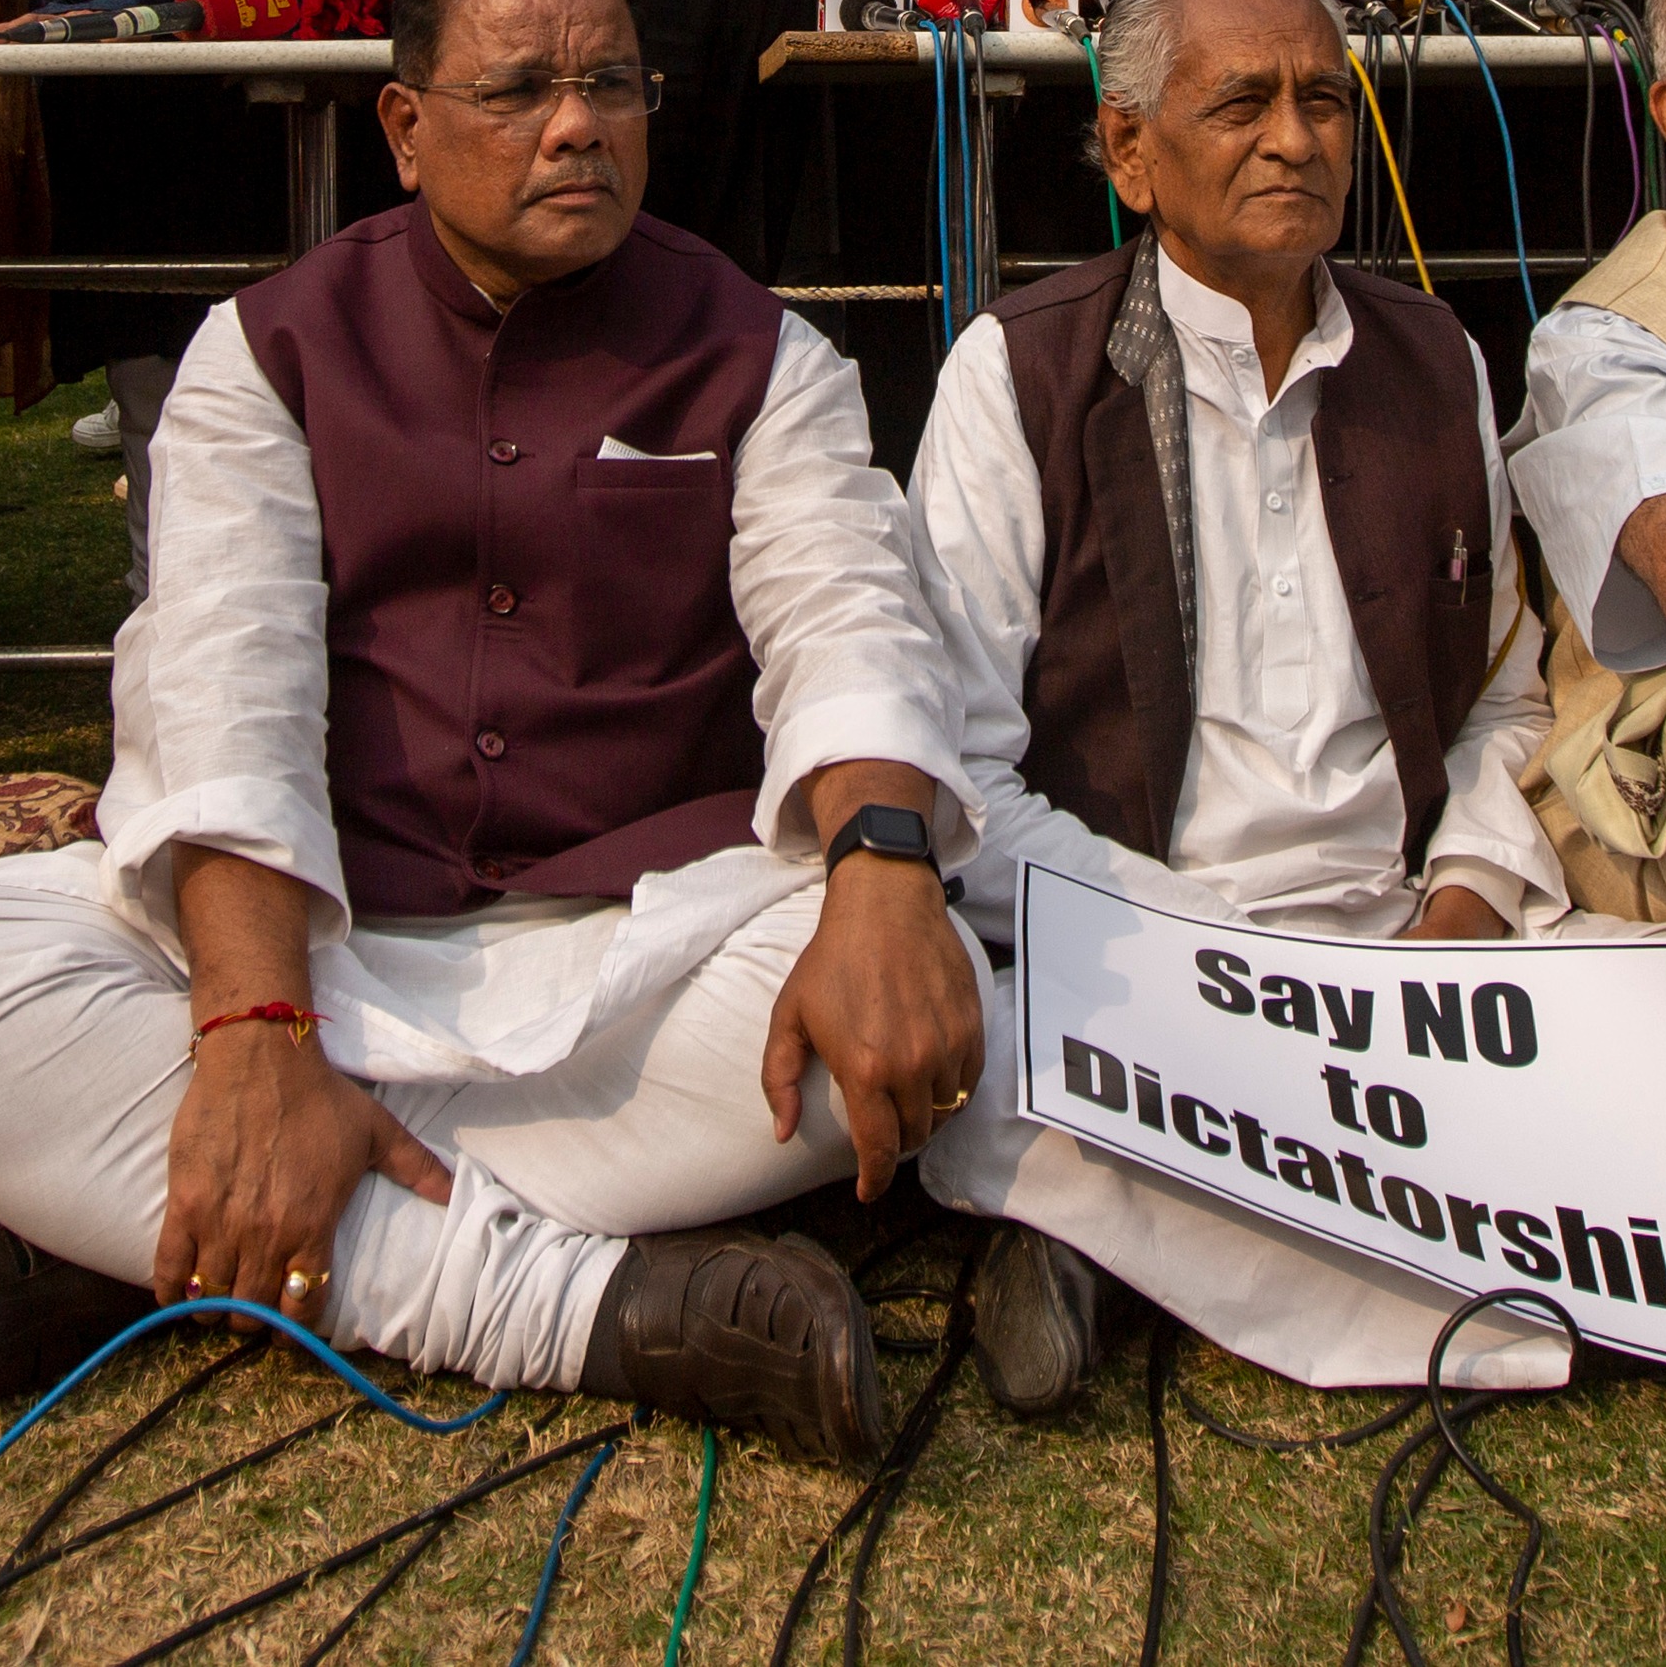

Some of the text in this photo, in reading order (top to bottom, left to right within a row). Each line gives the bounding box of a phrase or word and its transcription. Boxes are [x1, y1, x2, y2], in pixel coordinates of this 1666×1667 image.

[1194, 948, 1539, 1069] Say NO
[1320, 1063, 1429, 1150] to
